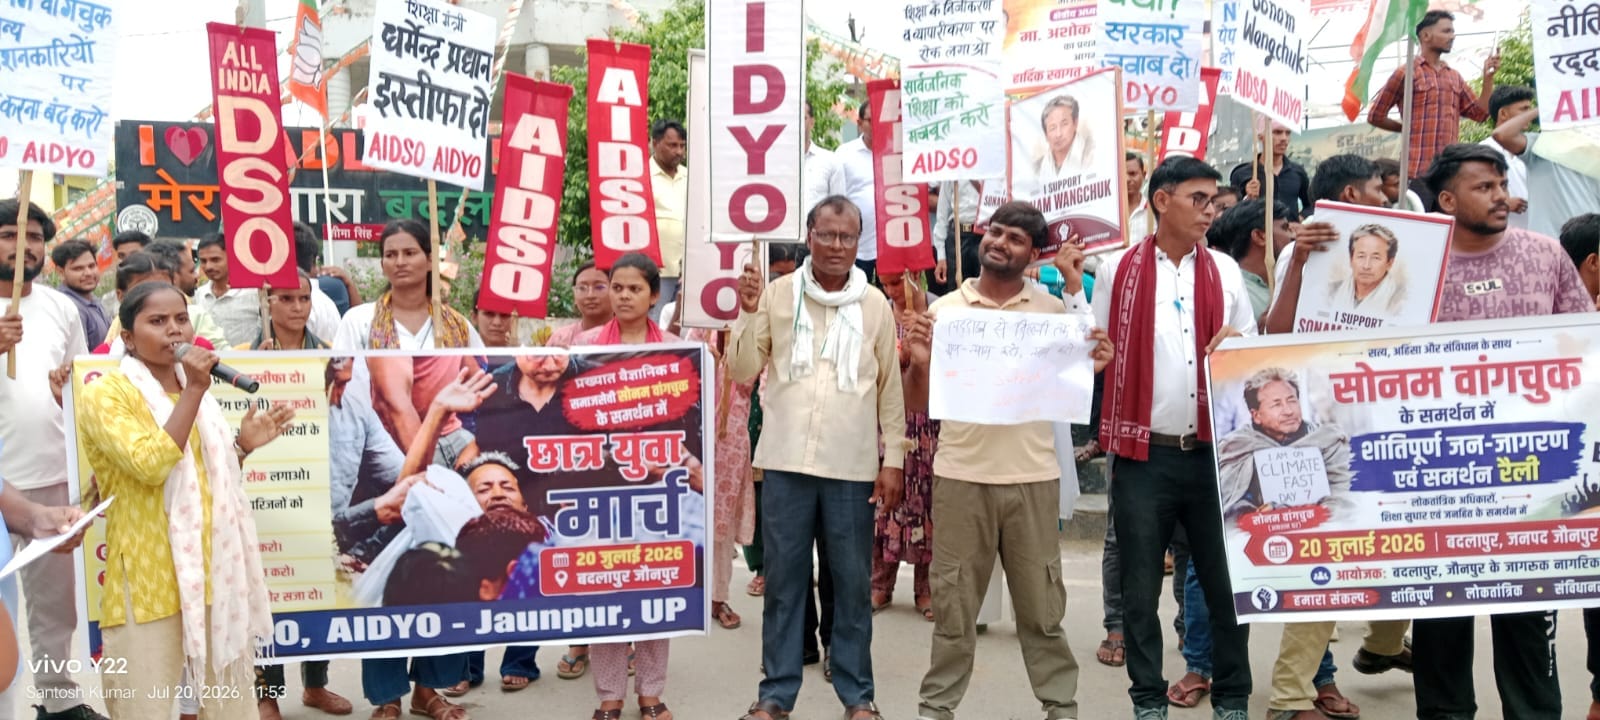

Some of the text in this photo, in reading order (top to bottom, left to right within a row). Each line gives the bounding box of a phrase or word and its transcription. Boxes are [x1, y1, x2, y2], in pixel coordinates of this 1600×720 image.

[980, 20, 998, 35] पर
[1105, 22, 1190, 48] सरकार
[1243, 10, 1305, 74] Wangchuk
[222, 42, 262, 71] ALL
[443, 41, 493, 82] प्रधान
[60, 73, 92, 92] पर
[219, 69, 271, 95] INDIA
[904, 70, 967, 95] सार्वजनिक
[1126, 81, 1178, 106] DYO
[374, 69, 490, 139] इस्तीफा दो
[1234, 67, 1301, 125] AIDSO AIDYO
[23, 141, 95, 168] AIDYO
[368, 131, 481, 178] AIDSO AIDYO
[596, 67, 651, 251] AIDSO
[911, 147, 978, 175] AIDSO
[217, 95, 290, 275] DSO
[1048, 174, 1082, 194] SUPPORT
[1053, 179, 1112, 210] WANGCHUK
[489, 113, 563, 301] AIDSO
[1341, 312, 1384, 328] SUPPORT
[1424, 340, 1441, 354] और
[1443, 339, 1479, 353] संविधान
[1481, 337, 1490, 350] के
[1491, 338, 1512, 350] साथ
[618, 363, 667, 382] वैज्ञानिक
[670, 362, 680, 374] व
[1328, 354, 1583, 404] सोनम वांगचुक
[569, 378, 689, 410] समाजसेवी सोनम वांगचुक
[595, 399, 668, 426] के समर्थन में
[1399, 401, 1497, 424] के समर्थन में
[310, 424, 320, 436] के
[524, 430, 685, 480] छात्र युवा
[1361, 429, 1570, 465] शांतिपूर्ण जन-जागरण
[246, 471, 267, 483] रोक
[1260, 457, 1321, 477] CLIMATE
[1393, 454, 1541, 489] एवं समर्थन रैली
[1283, 474, 1314, 489] FAST
[290, 496, 303, 509] को
[547, 469, 689, 541] मार्च
[1279, 493, 1297, 502] DAY
[1475, 507, 1483, 518] के
[1486, 506, 1517, 517] समर्थन
[1519, 505, 1528, 515] में
[576, 544, 683, 570] 20 जुलाई 2026
[1300, 525, 1599, 563] 20 जुलाई 2026 बदलापुर, जनपद जौनपुर
[576, 565, 680, 588] बदलापुर जौनपुर
[1336, 566, 1387, 581] आयोजक:
[1392, 565, 1442, 580] बदलापुर,
[1446, 560, 1485, 577] जौनपुर
[1489, 559, 1500, 573] के
[283, 591, 305, 601] सजा
[1293, 582, 1523, 606] हमारा संकल्प: शांतिपूर्ण लोकतांत्रिक
[326, 612, 442, 643] AIDYO
[475, 604, 631, 635] Jaunpur,
[641, 597, 687, 625] UP
